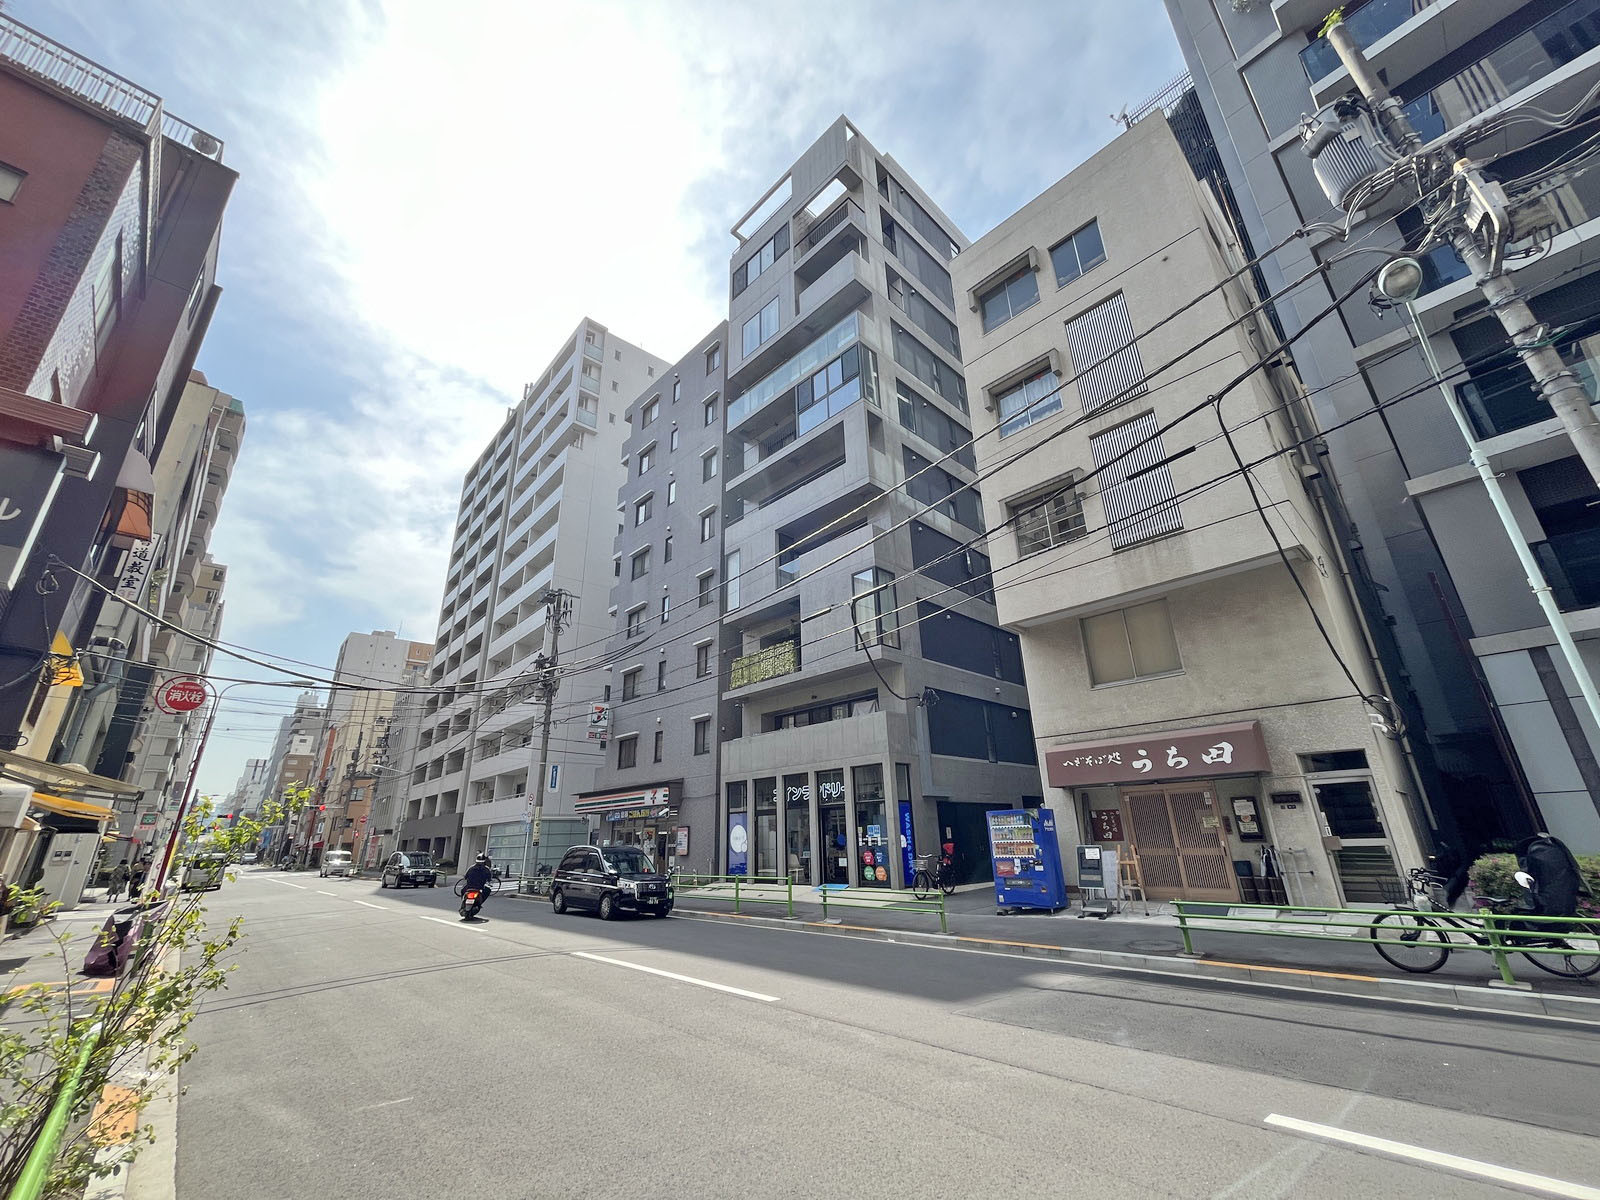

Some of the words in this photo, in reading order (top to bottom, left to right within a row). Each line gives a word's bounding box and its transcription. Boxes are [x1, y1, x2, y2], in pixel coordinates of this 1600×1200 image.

[167, 689, 204, 703] 消火栓
[1132, 741, 1234, 774] うち田
[904, 812, 913, 844] WASH
[1101, 812, 1113, 839] うち田
